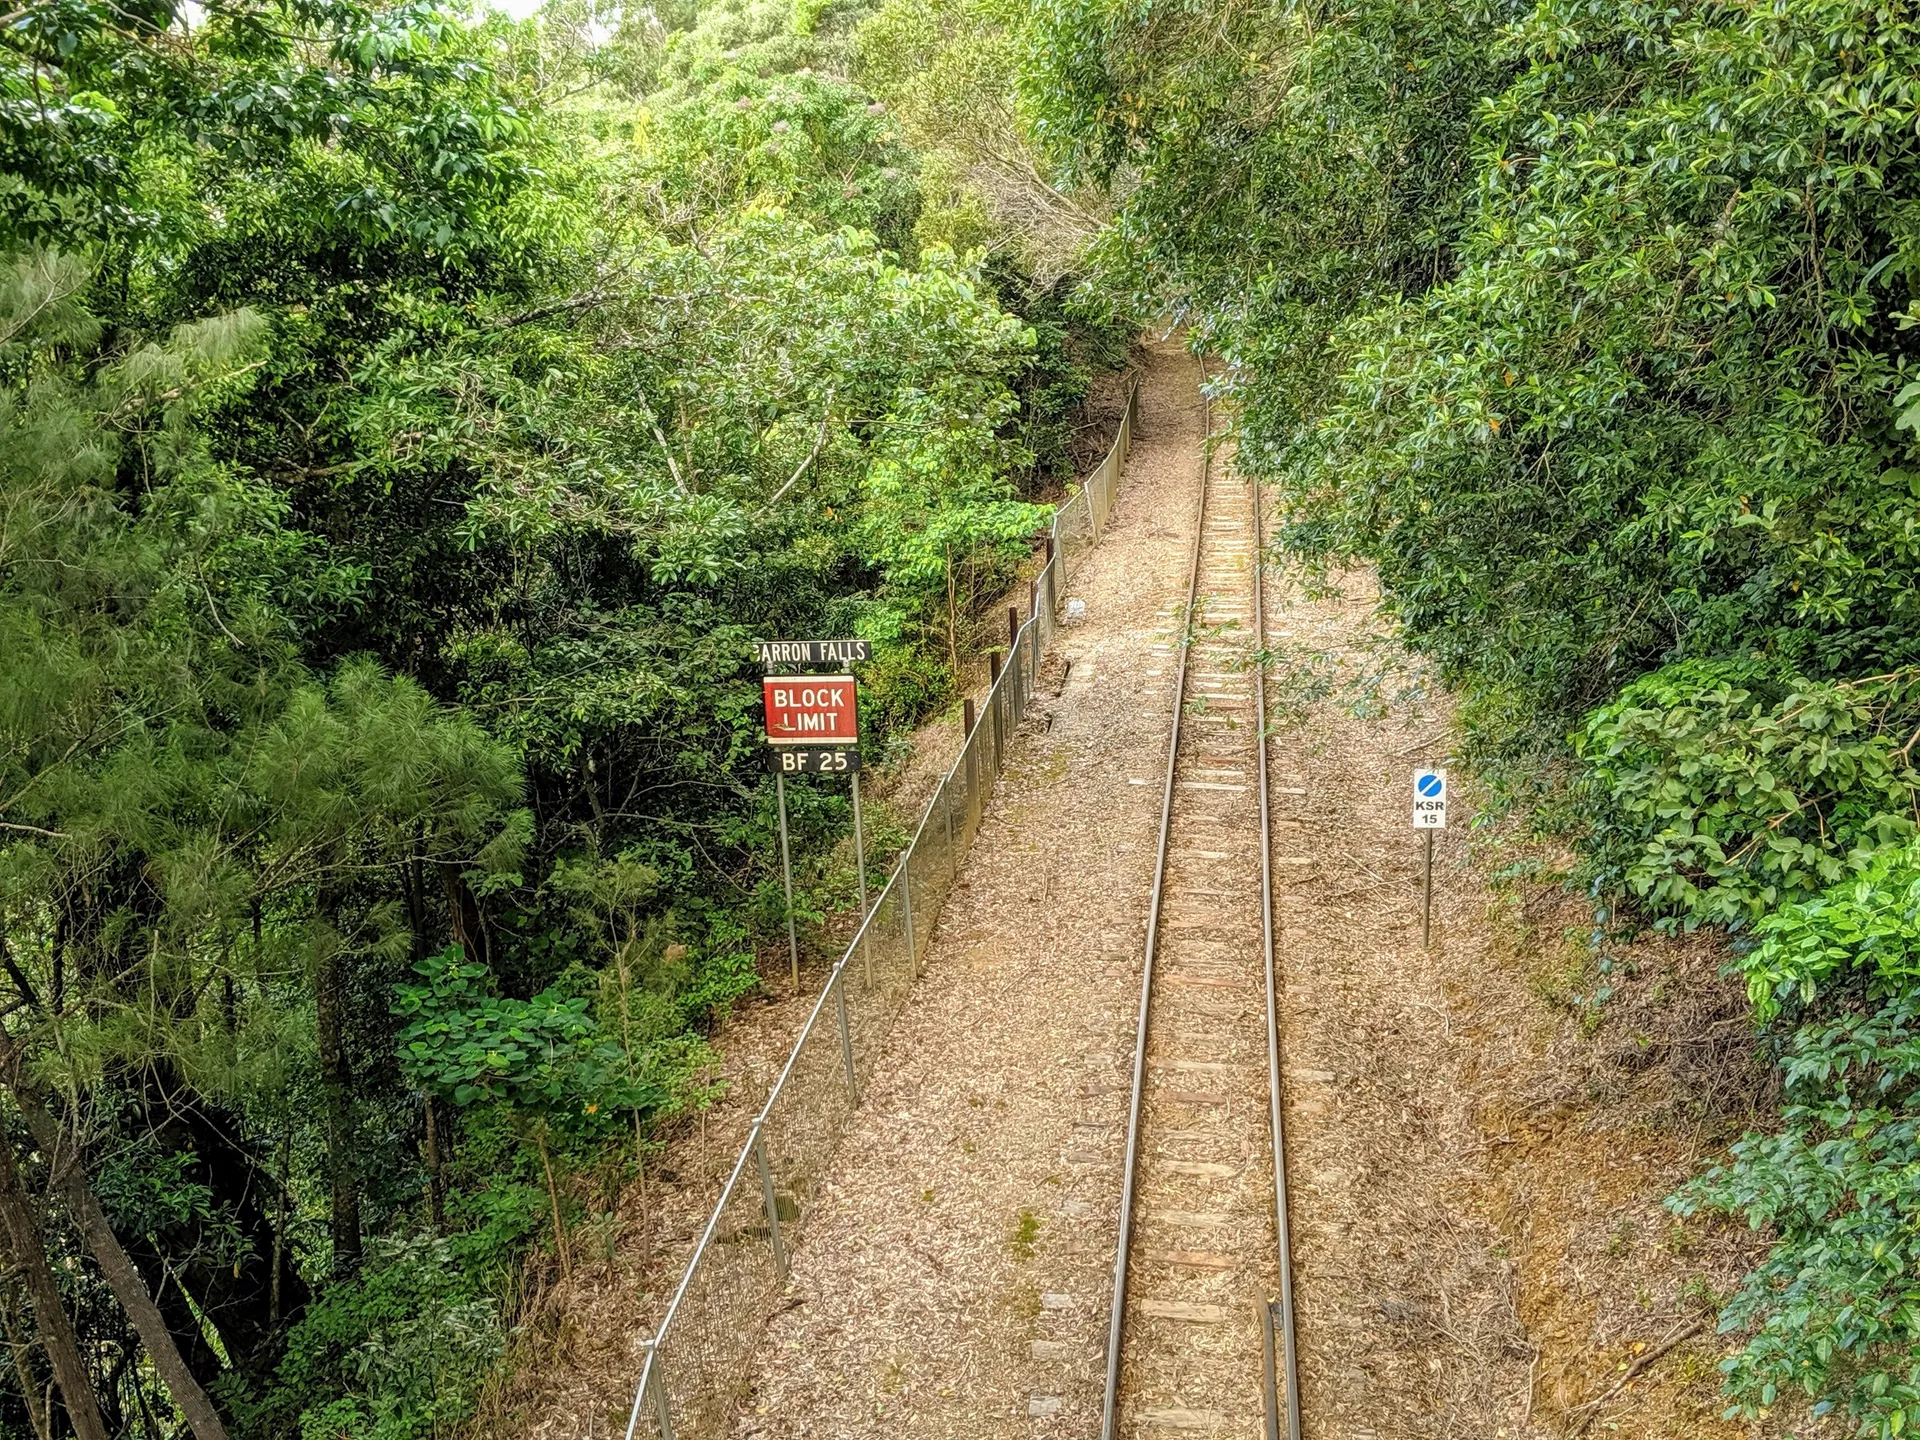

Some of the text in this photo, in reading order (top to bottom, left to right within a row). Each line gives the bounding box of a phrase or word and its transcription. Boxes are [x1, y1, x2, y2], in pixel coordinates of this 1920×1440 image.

[820, 642, 866, 661] FALLS
[774, 688, 844, 707] BLOCK
[783, 712, 838, 731] LIMIT
[781, 752, 848, 770] BF 25
[1415, 801, 1444, 810] KSR
[1422, 814, 1437, 824] 15
